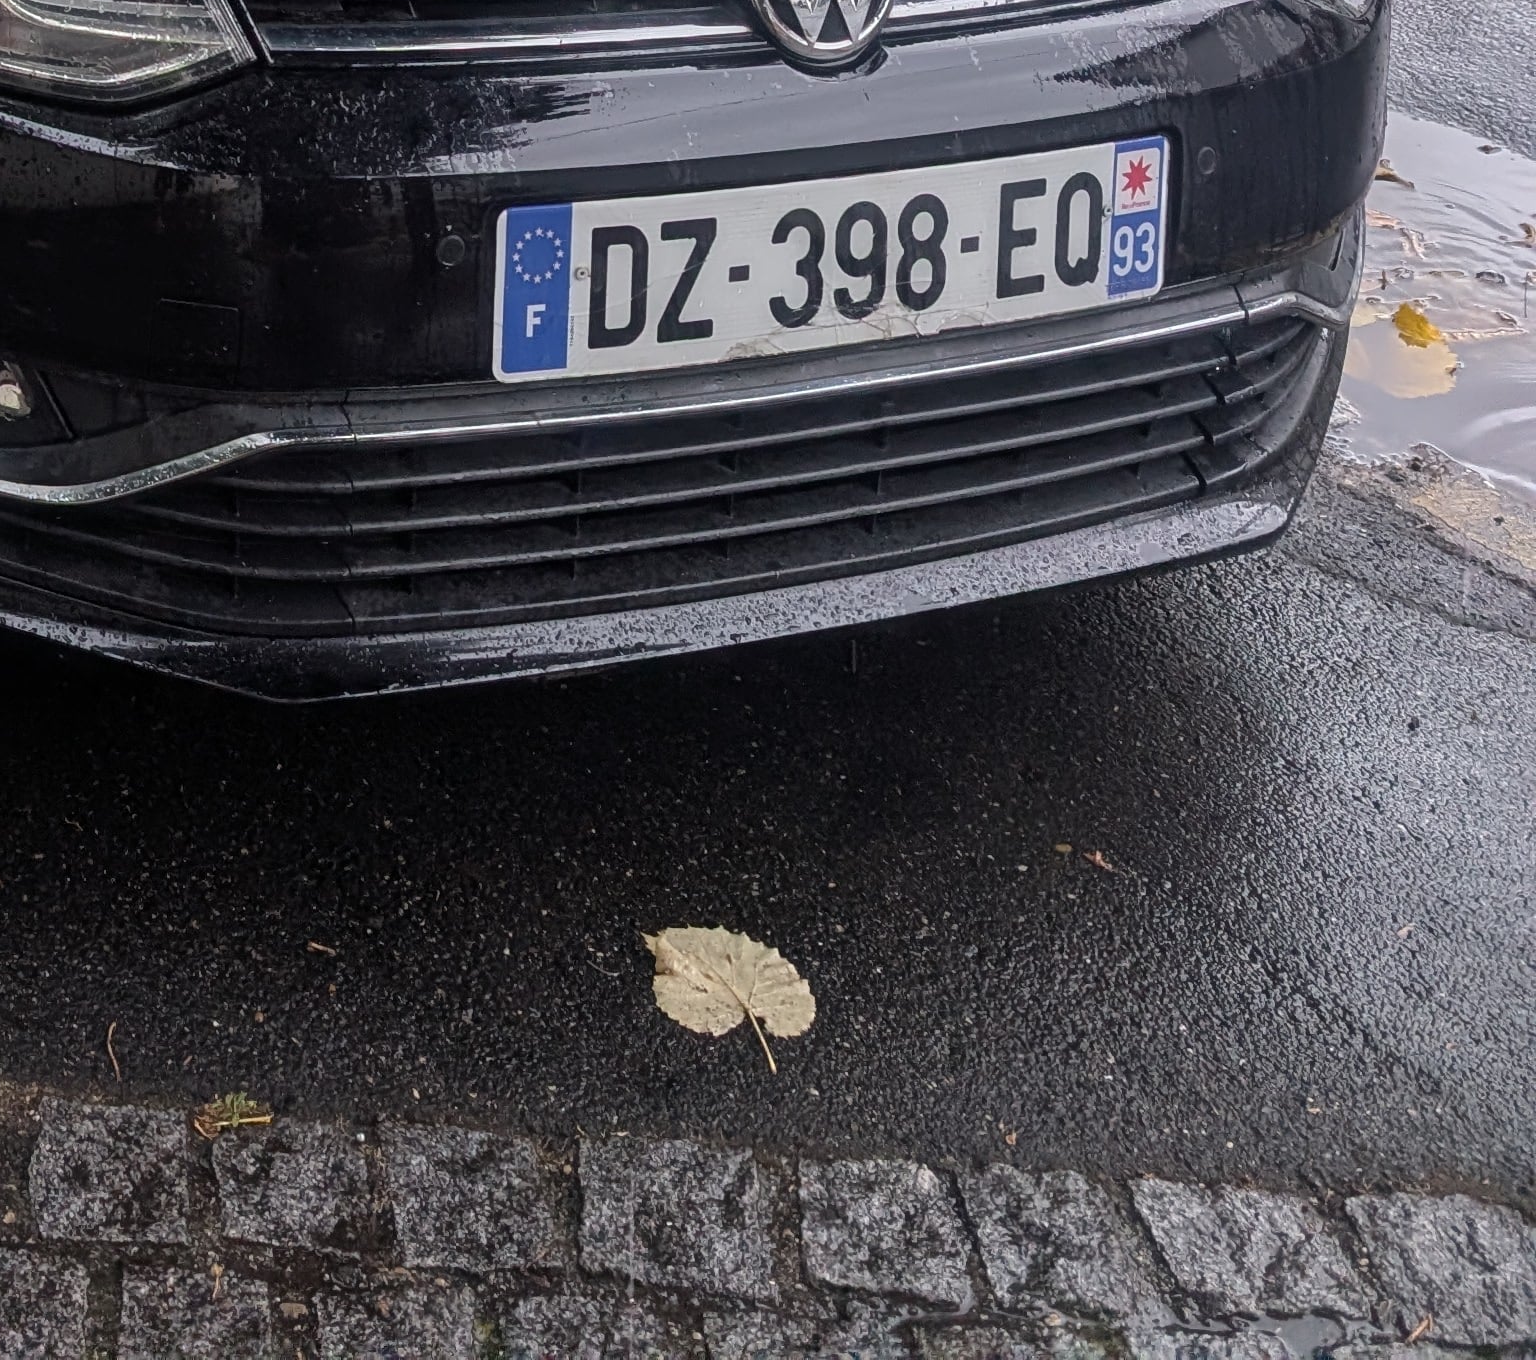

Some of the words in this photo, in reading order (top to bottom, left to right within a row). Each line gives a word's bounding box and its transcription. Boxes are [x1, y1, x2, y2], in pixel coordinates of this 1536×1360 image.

[587, 171, 1103, 350] DZ-398-EQ
[1113, 222, 1155, 276] 93
[526, 304, 546, 337] F
